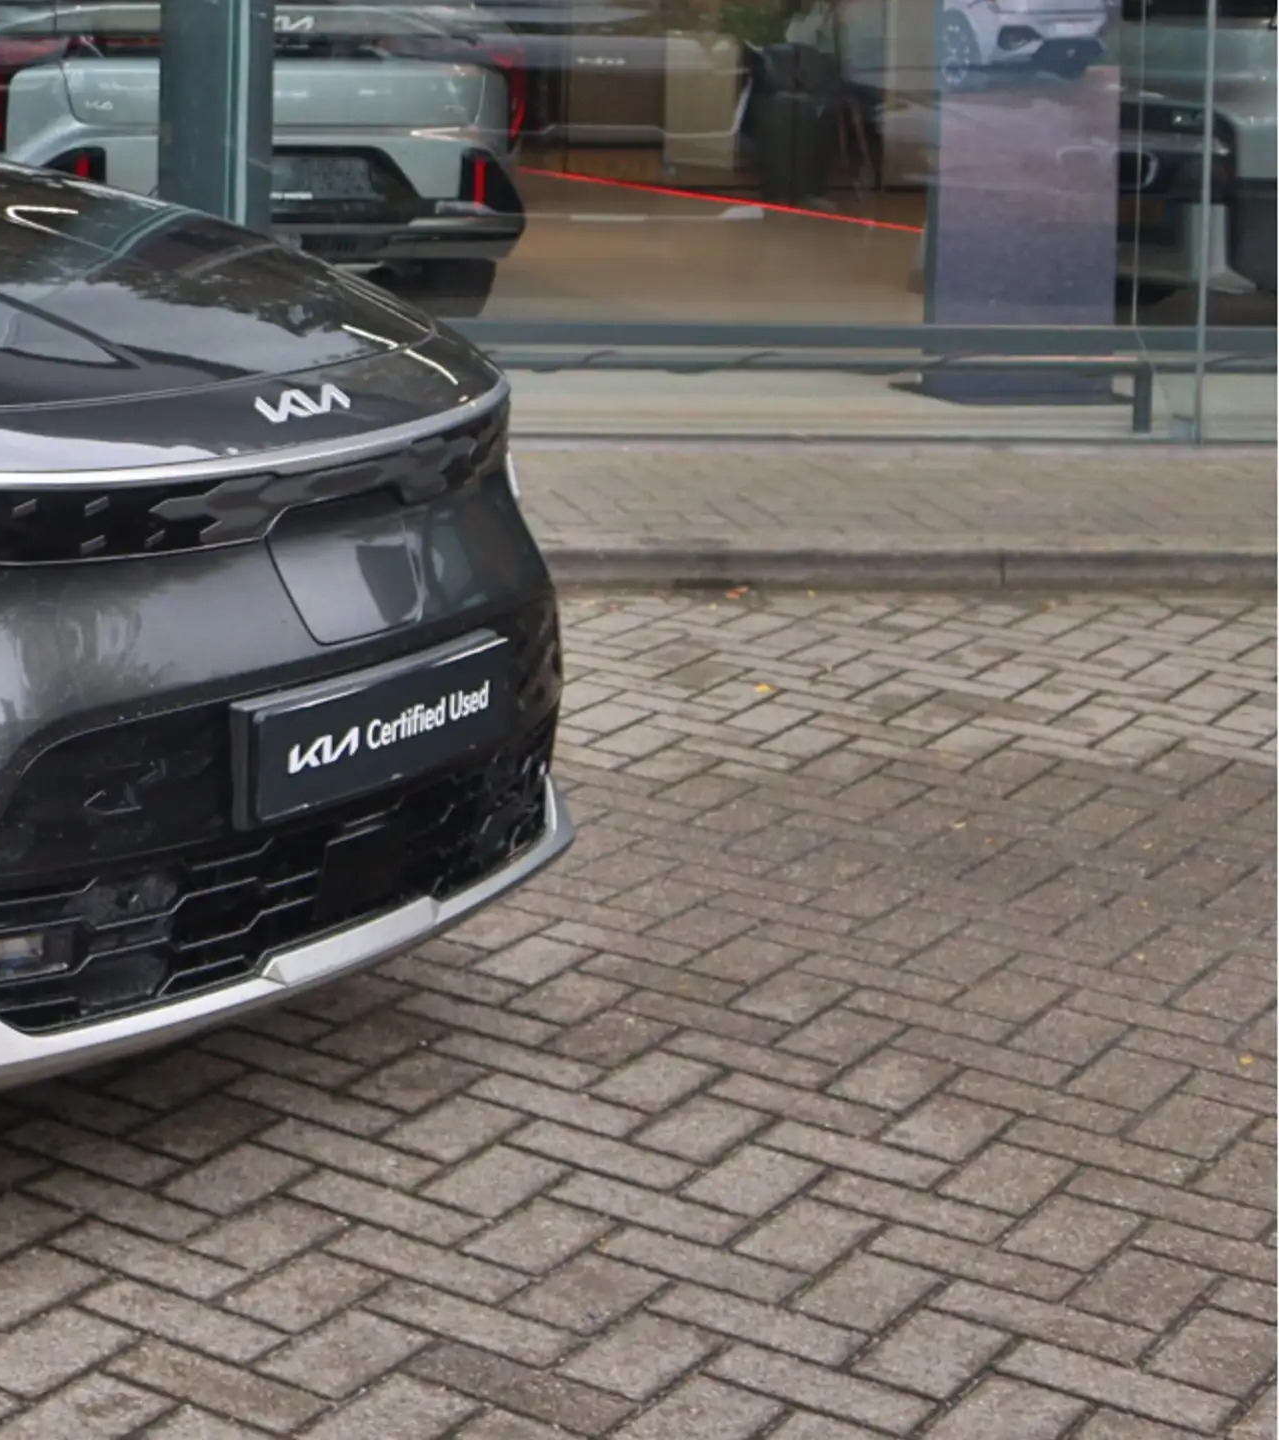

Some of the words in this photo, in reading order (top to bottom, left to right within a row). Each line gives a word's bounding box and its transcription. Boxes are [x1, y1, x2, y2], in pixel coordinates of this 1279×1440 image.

[254, 383, 351, 423] KIA
[288, 725, 360, 774] KIA
[365, 696, 447, 750] Certified
[449, 679, 491, 722] Used
